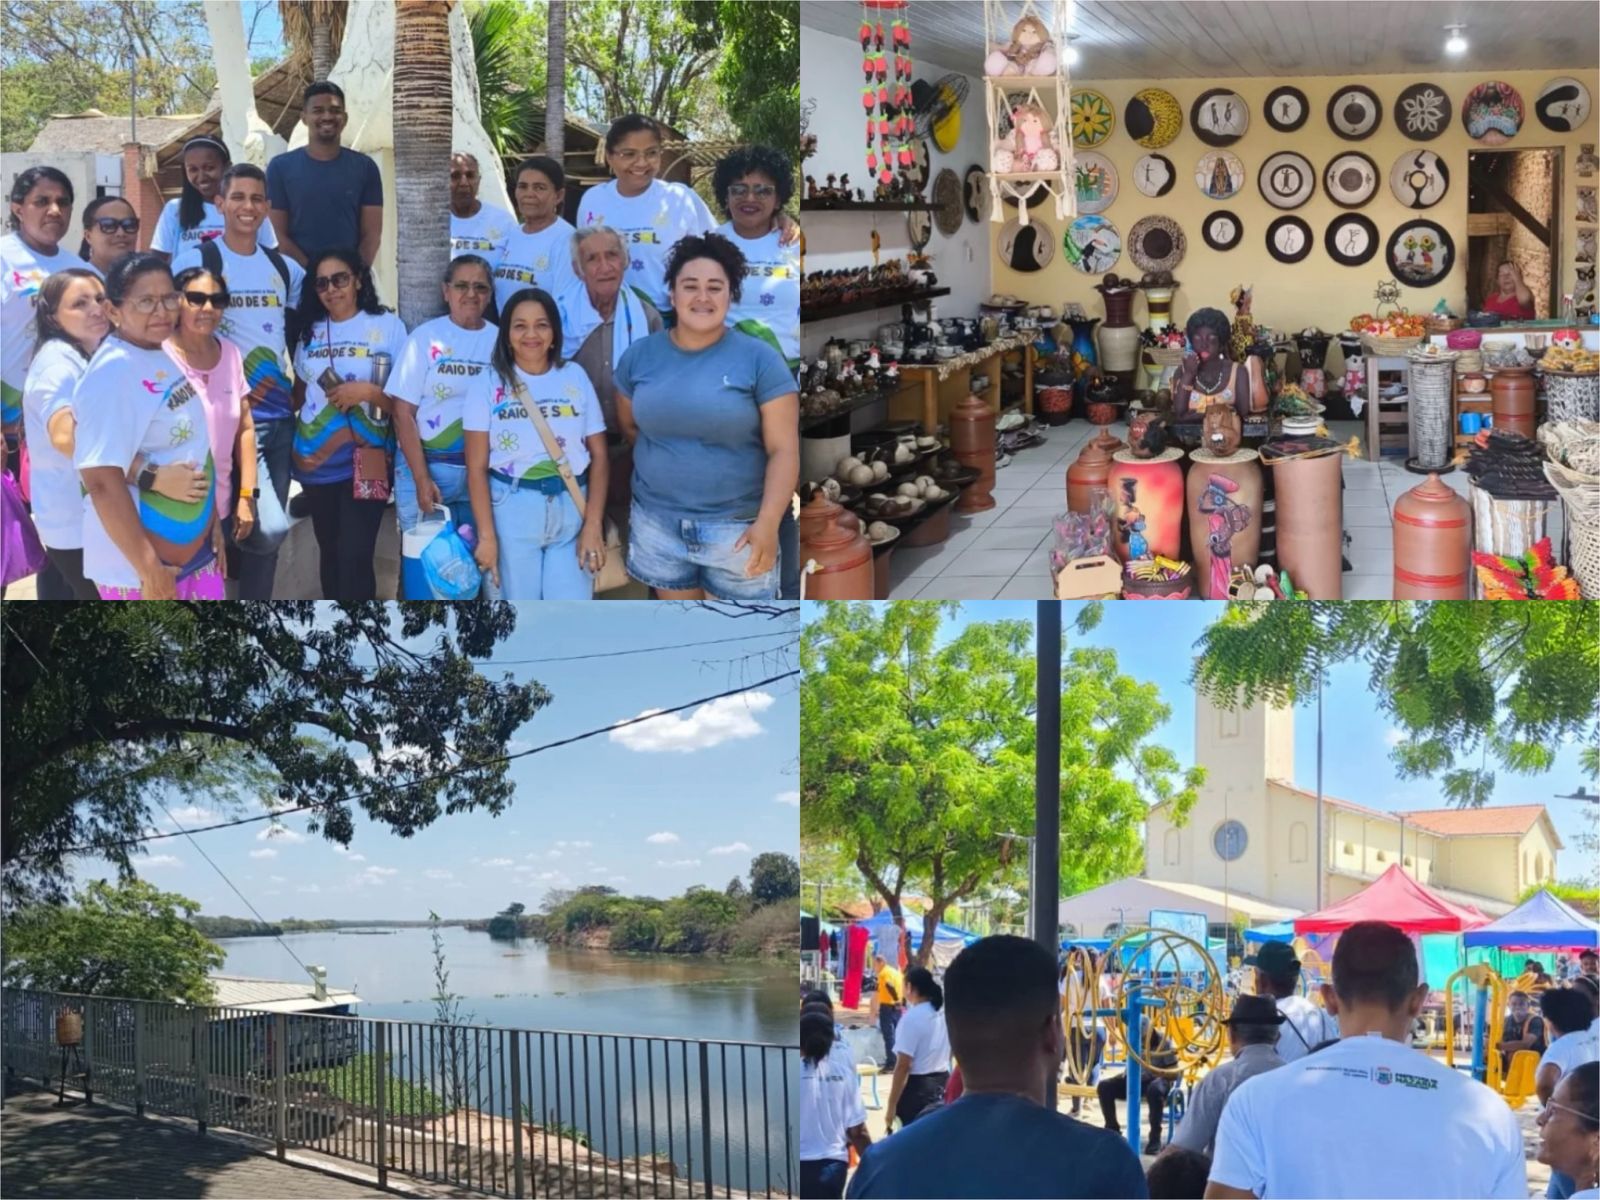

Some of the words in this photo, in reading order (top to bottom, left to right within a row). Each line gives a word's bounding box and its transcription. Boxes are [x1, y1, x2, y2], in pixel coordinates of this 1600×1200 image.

[246, 296, 259, 307] DE
[262, 295, 282, 307] SOL
[438, 363, 465, 375] RAIO
[167, 387, 189, 410] RAIO
[498, 407, 528, 420] RAIO
[552, 405, 579, 418] SOL
